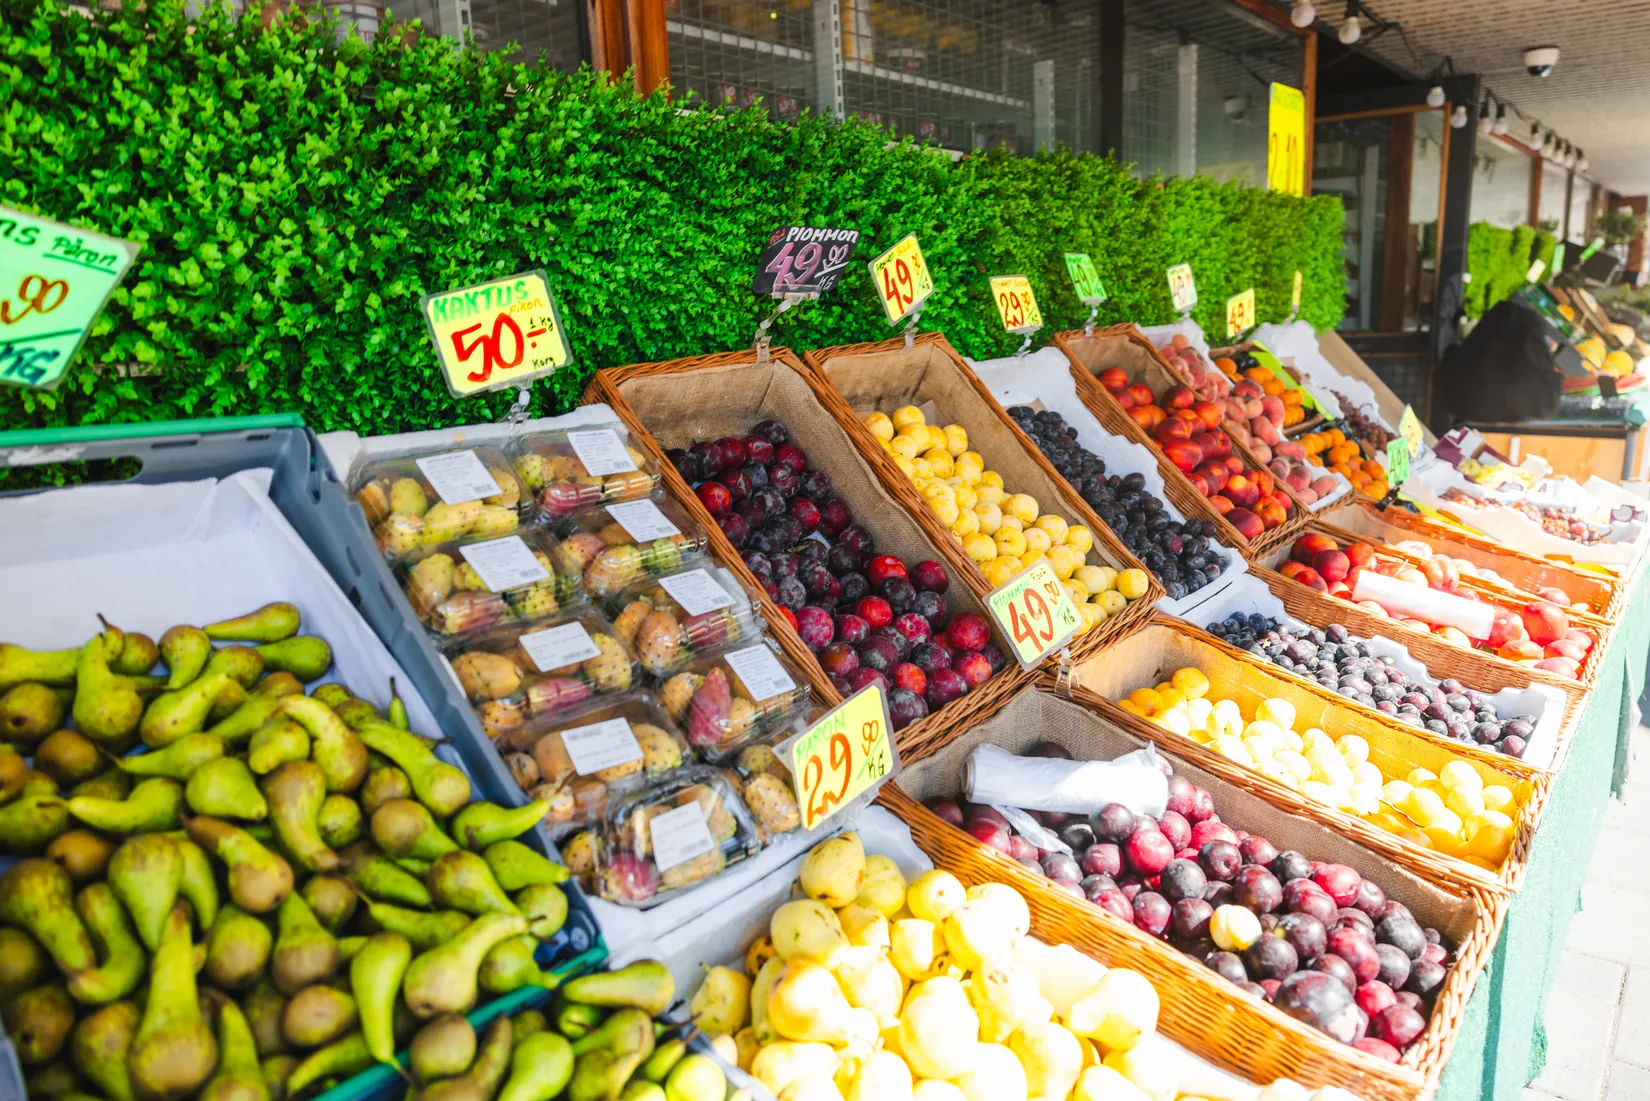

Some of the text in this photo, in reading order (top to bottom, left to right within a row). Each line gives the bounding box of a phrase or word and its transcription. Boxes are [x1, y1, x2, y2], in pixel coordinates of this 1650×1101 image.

[765, 241, 823, 290] 49
[883, 258, 914, 315] 49
[433, 280, 529, 324] KAKTUS
[509, 298, 543, 317] Fikon
[999, 291, 1025, 328] 29
[1008, 588, 1054, 653] 49
[803, 720, 879, 829] 29 90
